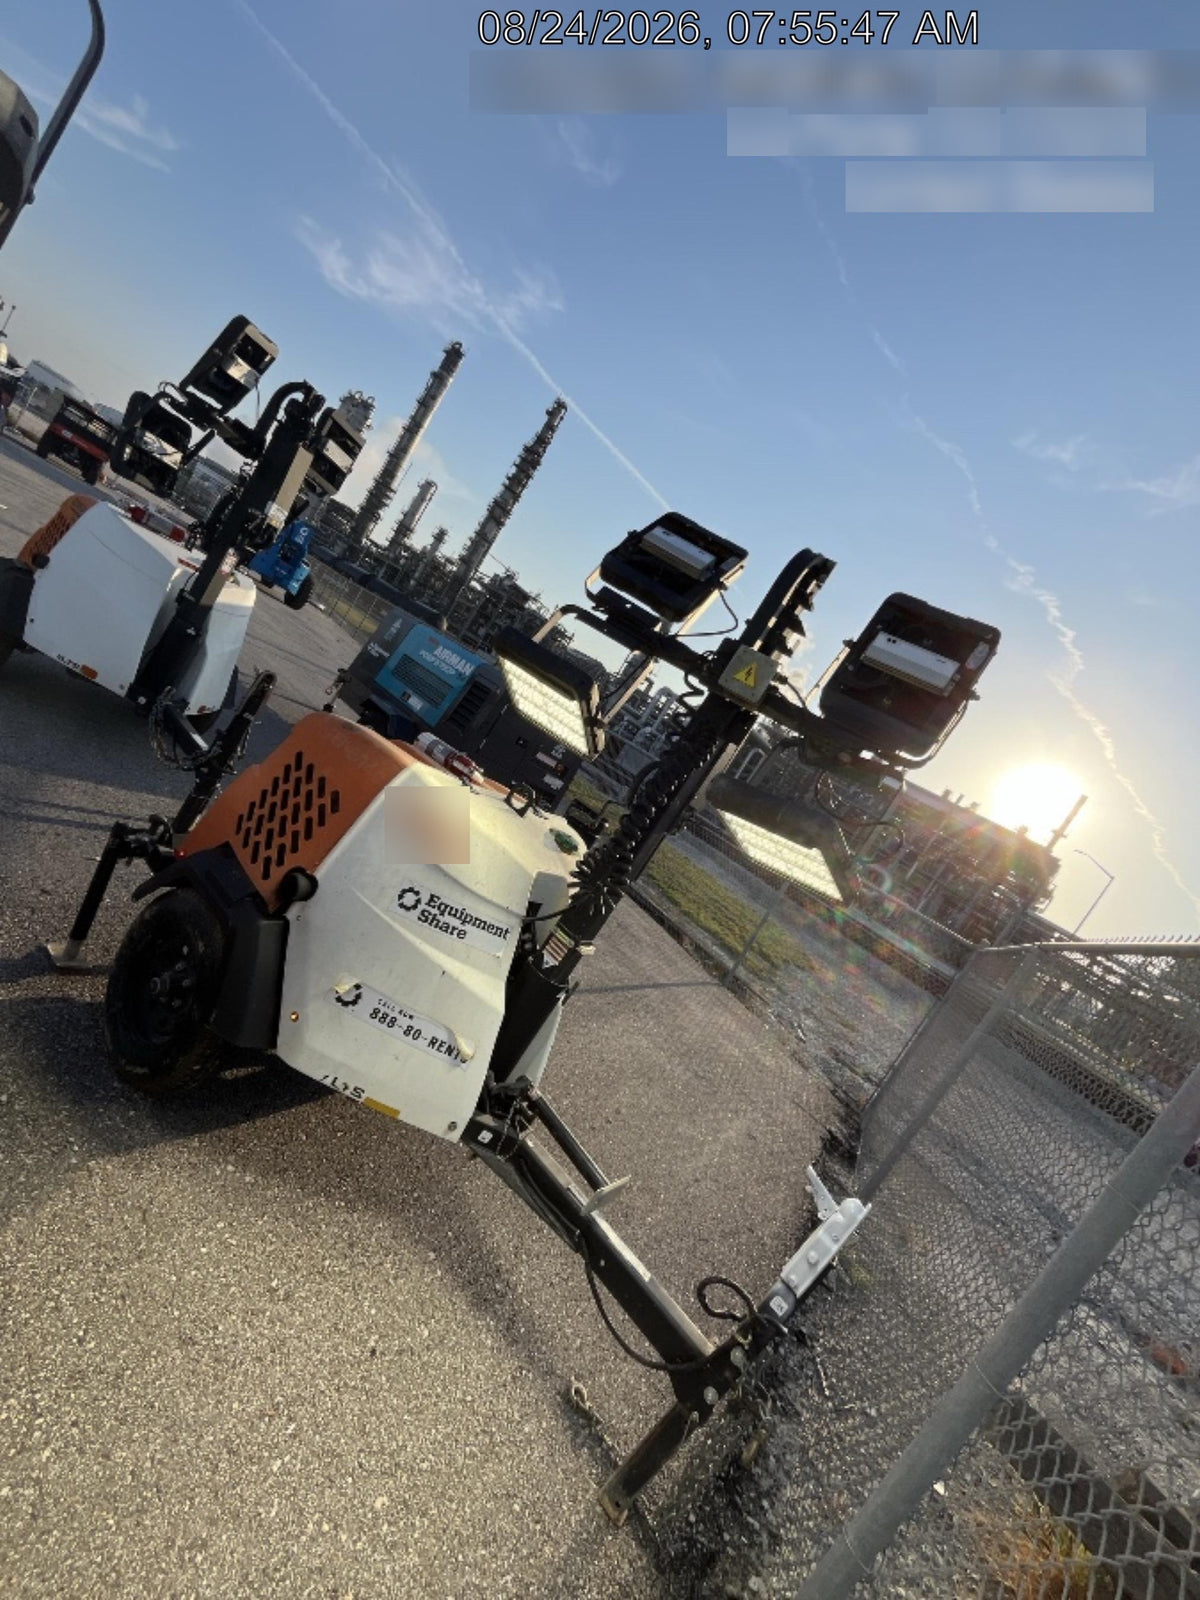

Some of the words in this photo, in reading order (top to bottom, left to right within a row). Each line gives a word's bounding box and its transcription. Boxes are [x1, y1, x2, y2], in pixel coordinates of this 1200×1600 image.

[433, 645, 476, 676] AIRMAN
[417, 909, 468, 940] Share
[424, 893, 511, 941] Equipment
